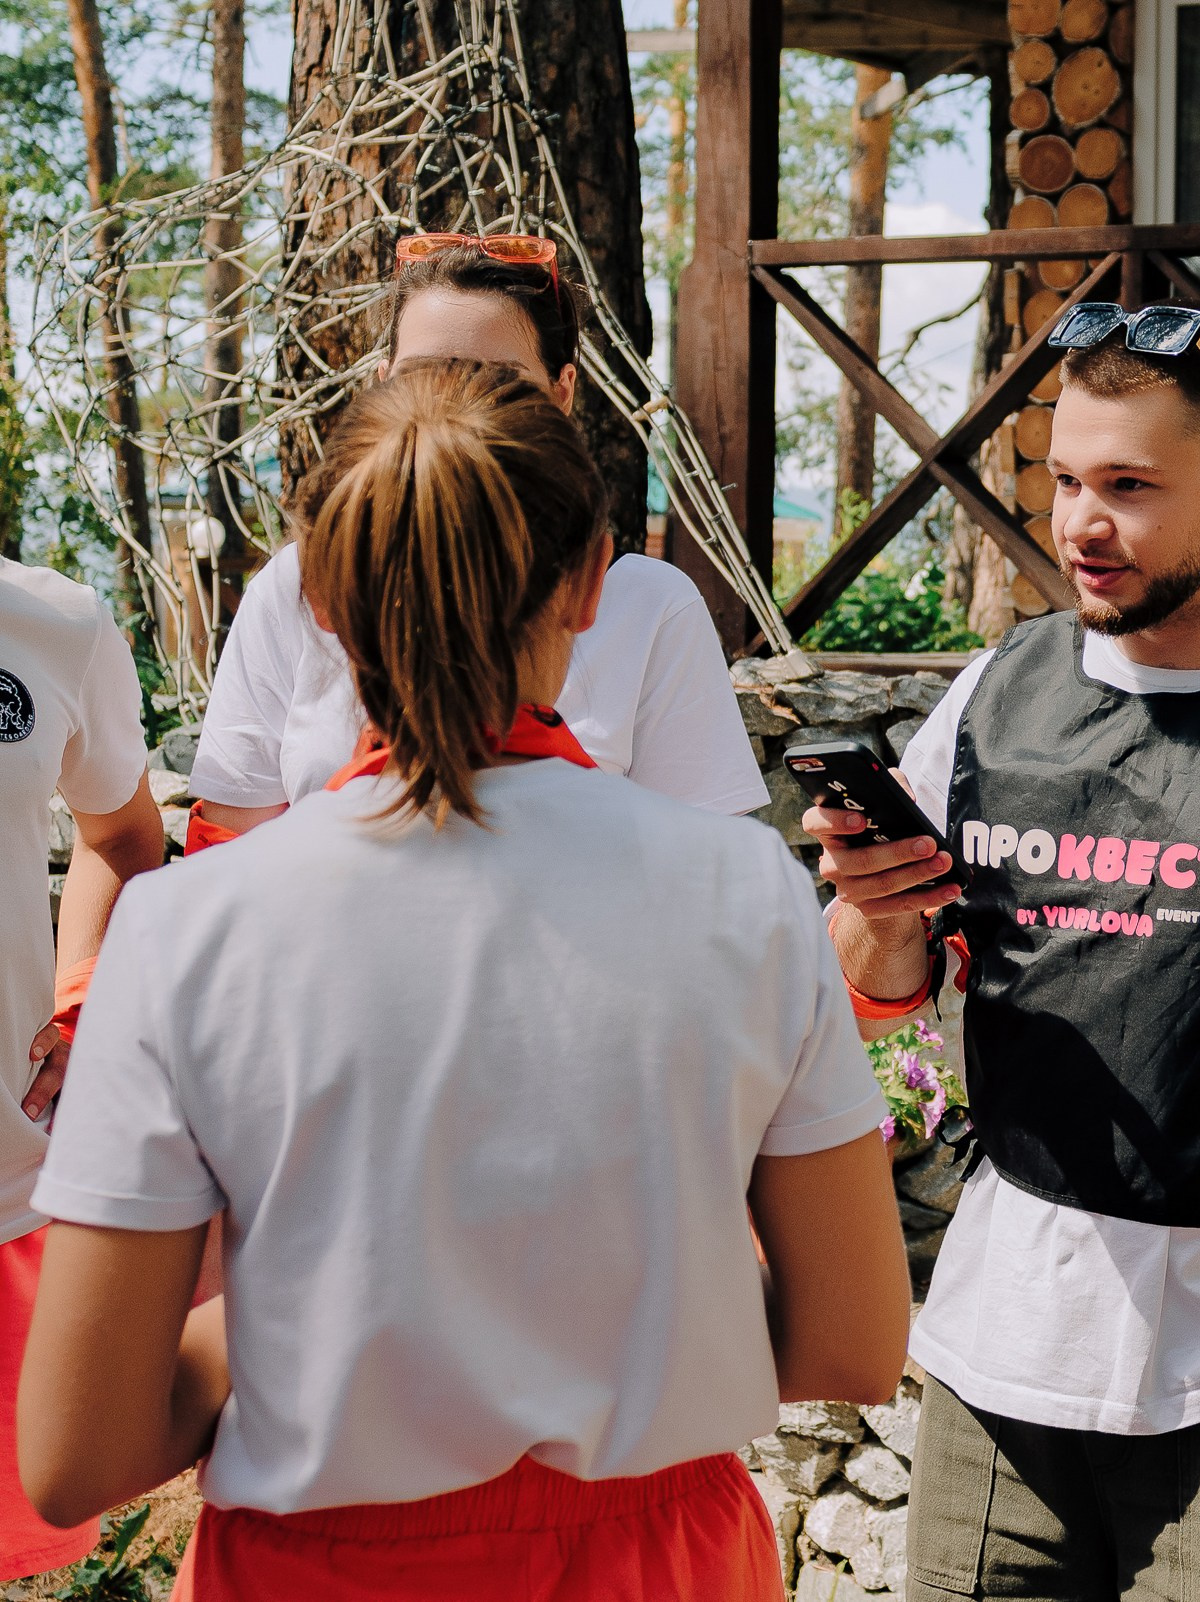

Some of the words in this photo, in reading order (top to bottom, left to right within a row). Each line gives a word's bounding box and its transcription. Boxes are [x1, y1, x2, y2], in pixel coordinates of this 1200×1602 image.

[1016, 908, 1038, 926] BY
[1042, 905, 1154, 938] YURLOVA
[1156, 908, 1200, 924] EVENT
